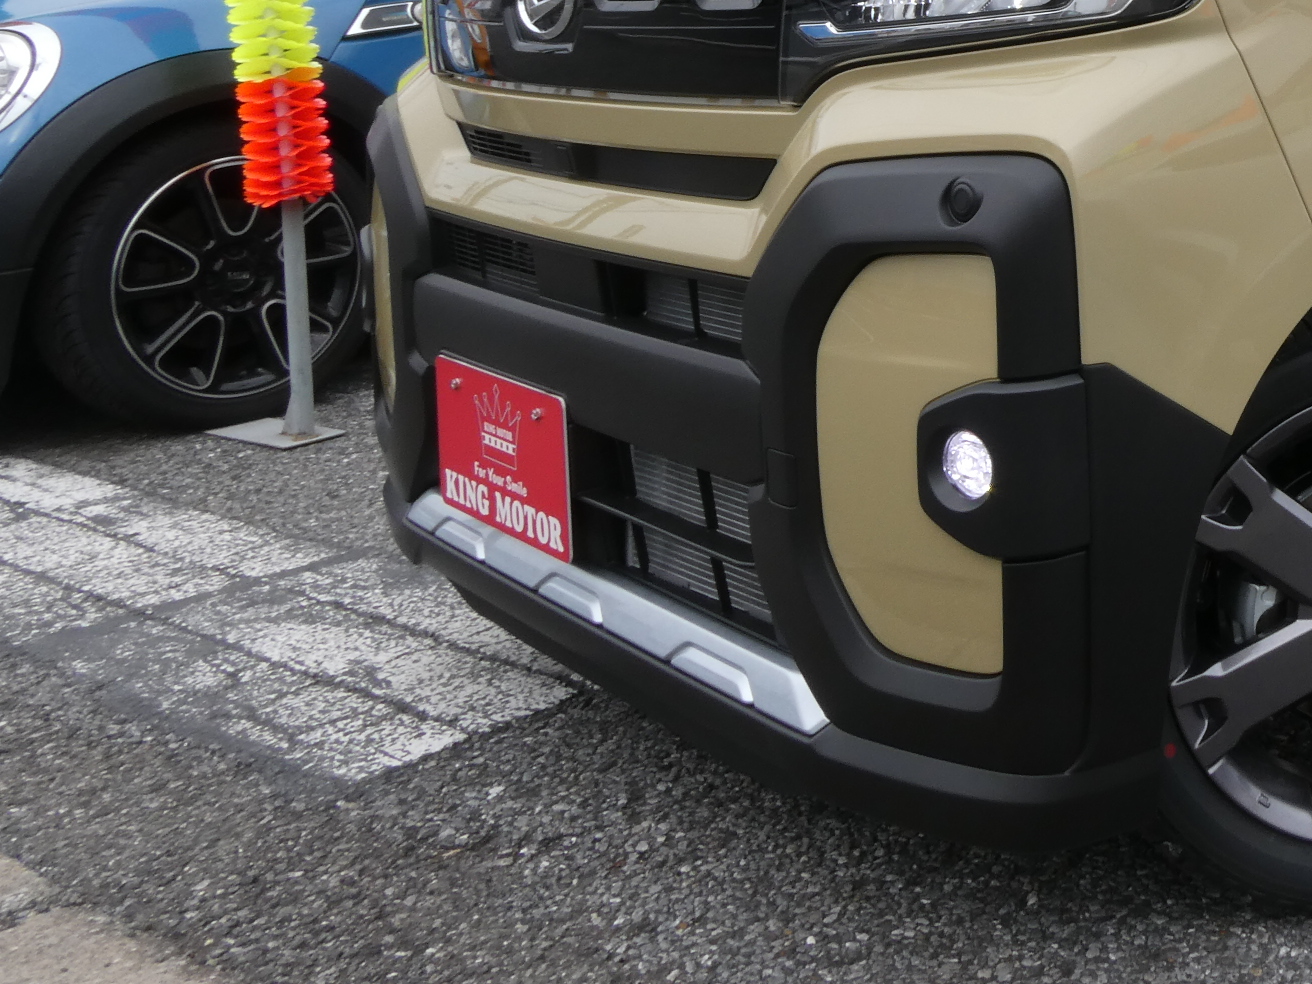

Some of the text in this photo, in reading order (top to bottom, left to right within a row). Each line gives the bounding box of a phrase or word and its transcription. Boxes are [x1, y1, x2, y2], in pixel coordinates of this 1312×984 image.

[474, 461, 528, 497] For Your Smile
[445, 468, 565, 553] KING MOTOR
